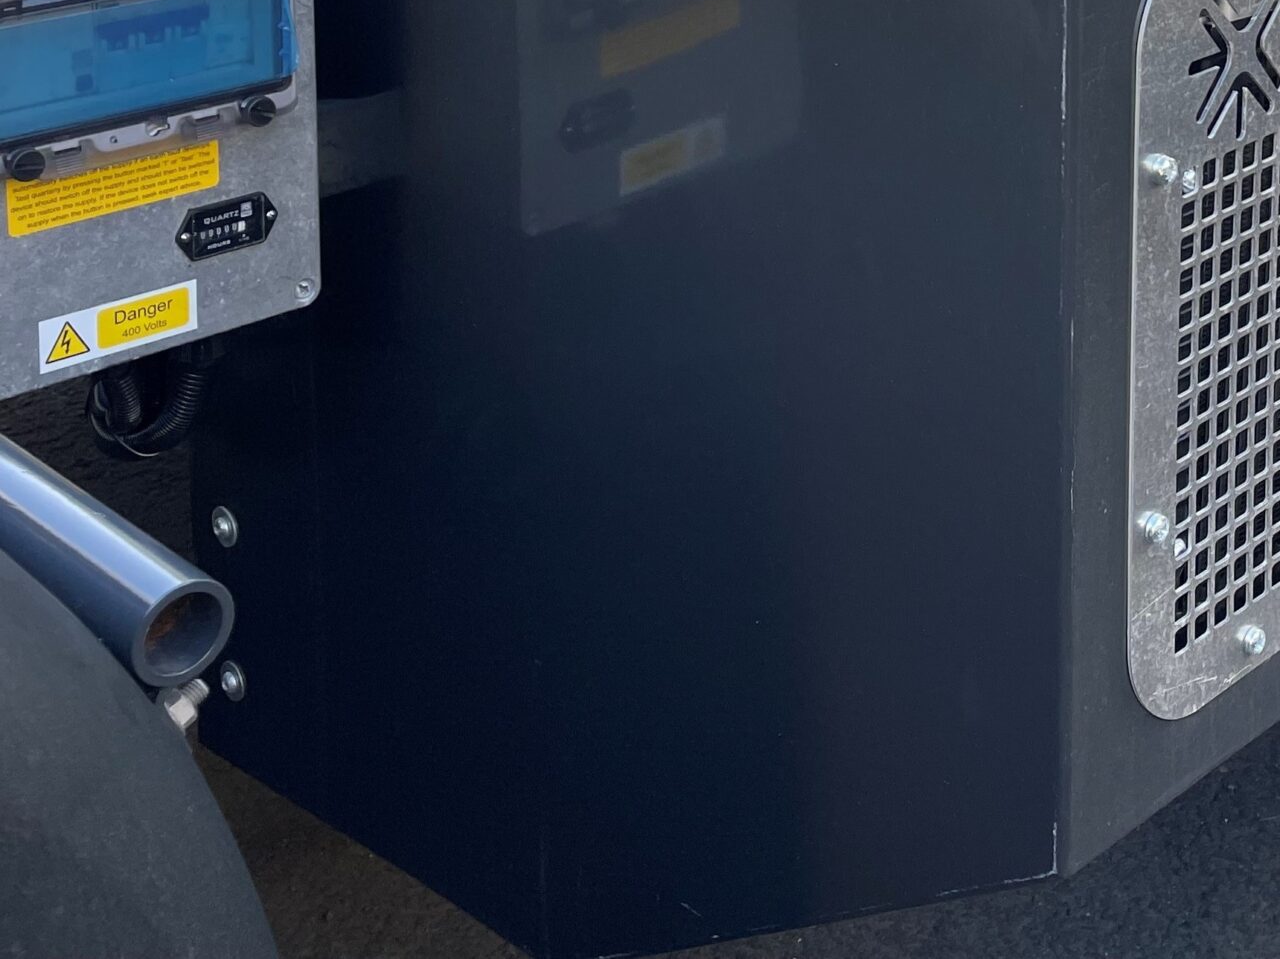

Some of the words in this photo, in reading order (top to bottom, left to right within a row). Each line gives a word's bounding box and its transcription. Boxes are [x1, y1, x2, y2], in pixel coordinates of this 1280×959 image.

[203, 210, 239, 225] QUARTZ
[114, 299, 173, 325] Danger
[122, 326, 141, 337] 400
[144, 319, 168, 331] Volts
